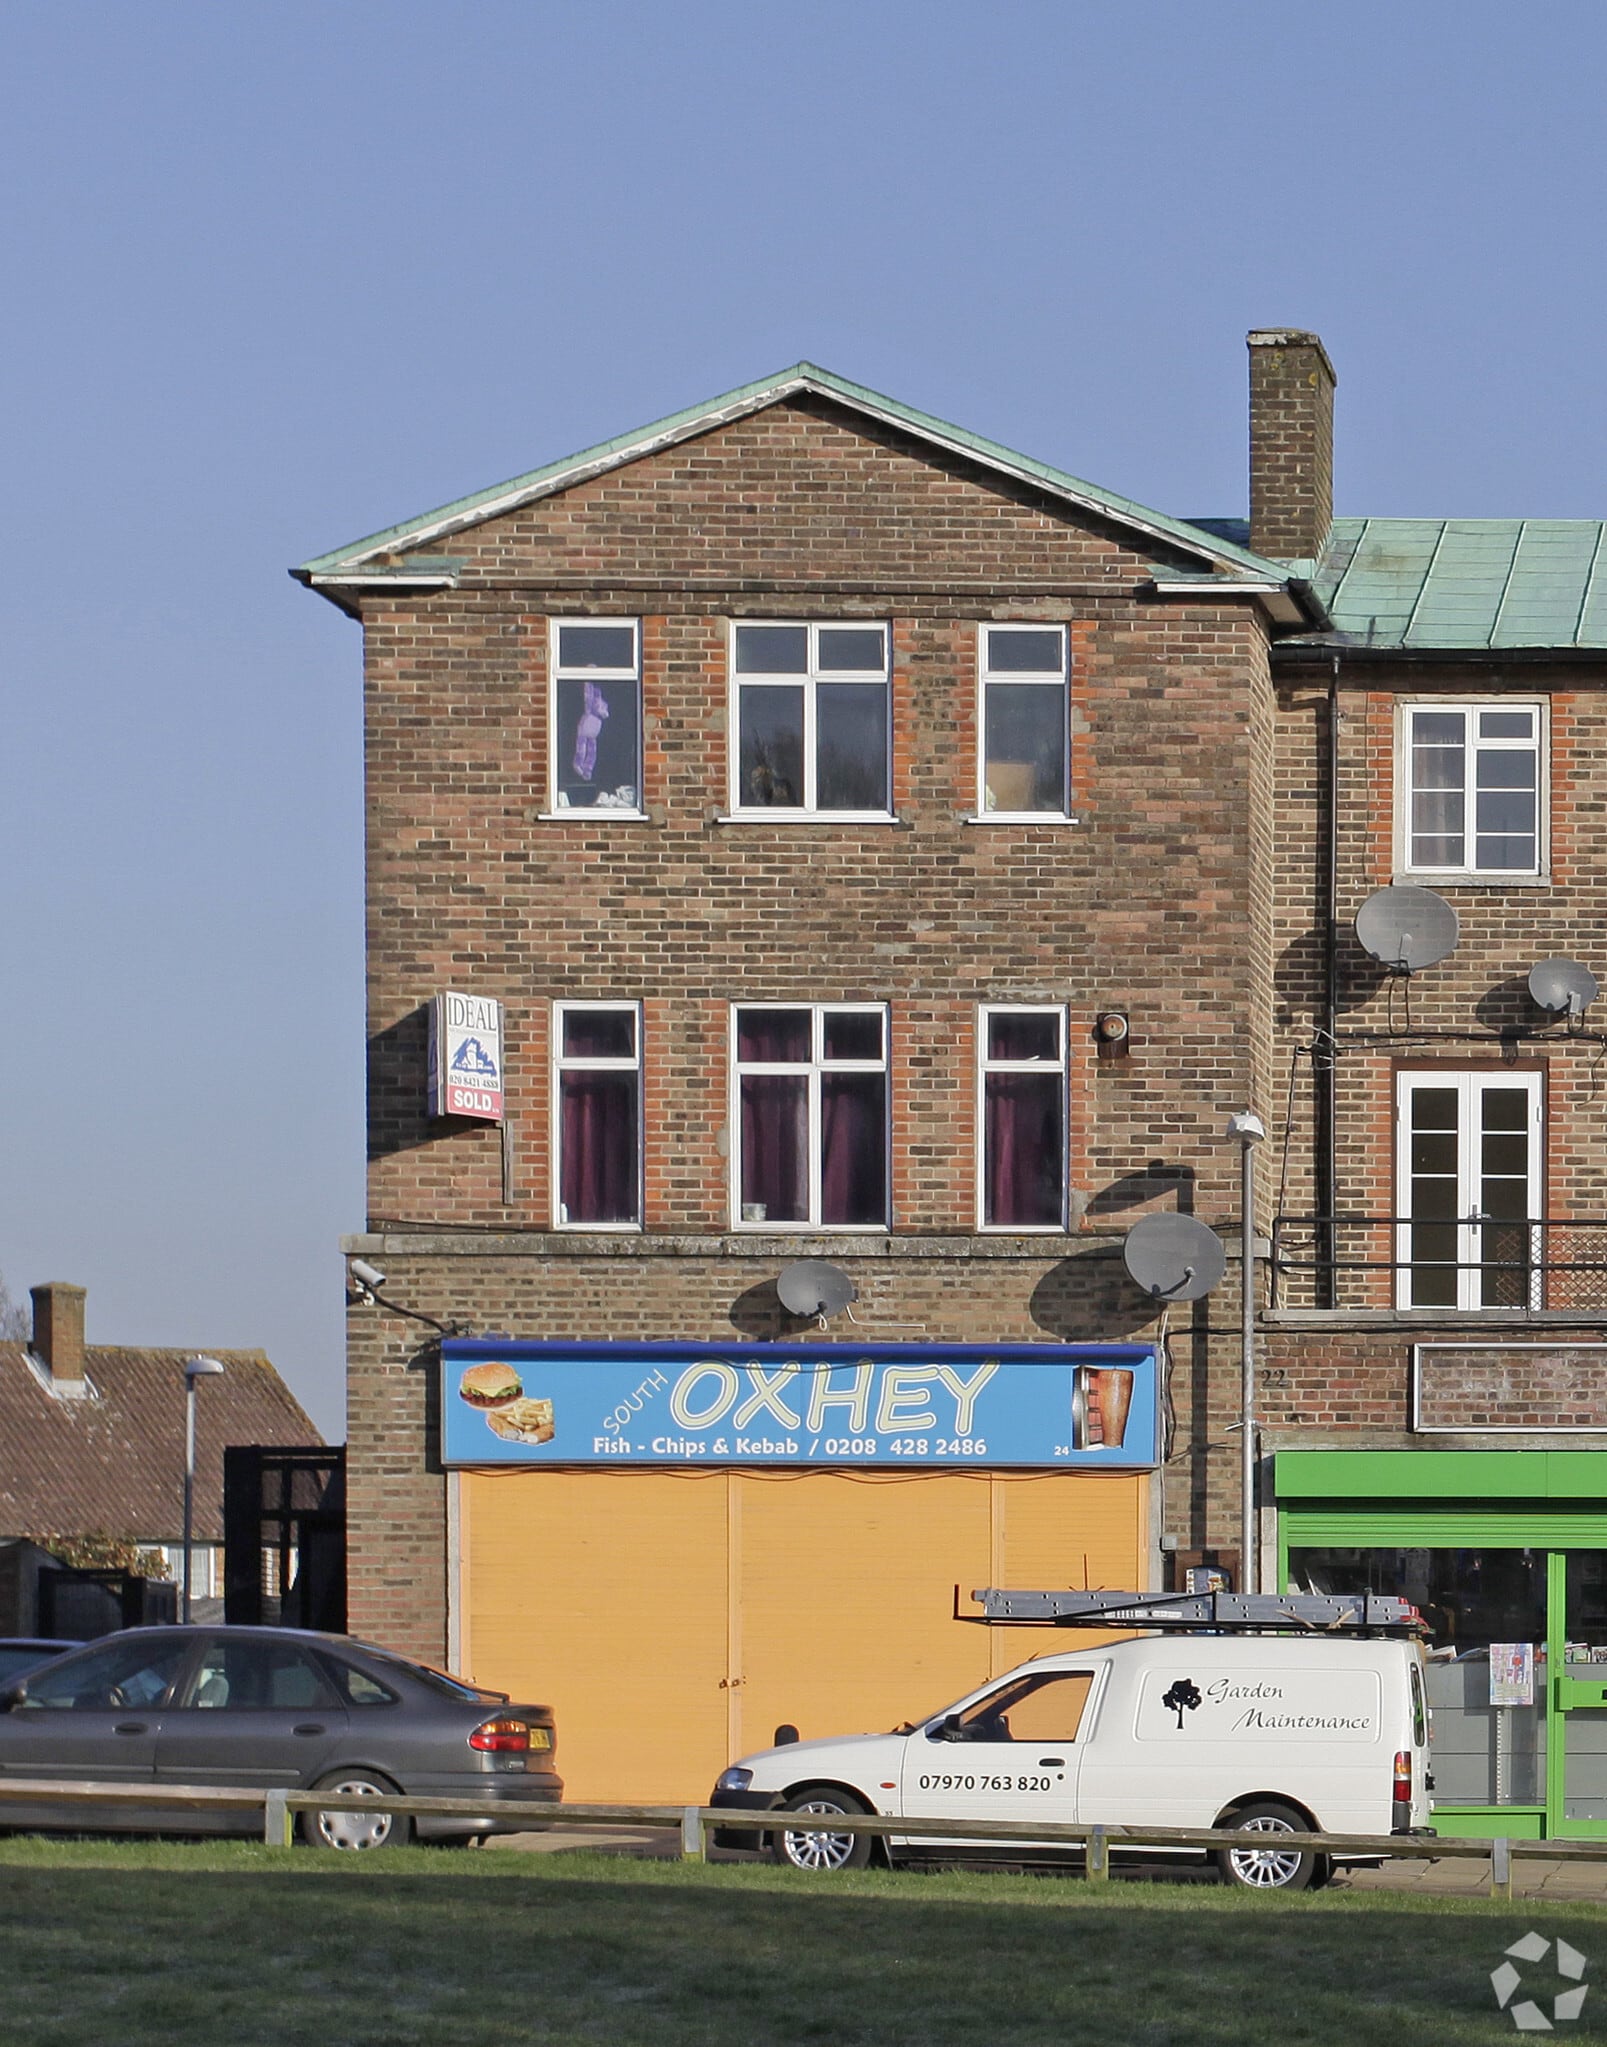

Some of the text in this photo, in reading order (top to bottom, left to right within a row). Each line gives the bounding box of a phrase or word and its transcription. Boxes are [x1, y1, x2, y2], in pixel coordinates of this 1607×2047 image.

[447, 996, 497, 1031] IDEAL
[453, 1089, 492, 1112] SOLD
[1260, 1369, 1288, 1387] 22
[603, 1368, 670, 1435] SOUTH
[670, 1359, 999, 1436] OXHEY
[593, 1437, 631, 1454] Fish
[652, 1437, 706, 1458] Chips
[713, 1438, 730, 1454] &
[736, 1437, 798, 1455] Kebab
[825, 1438, 877, 1455] 0208
[890, 1438, 928, 1455] 428
[935, 1438, 987, 1455] 2486
[1054, 1445, 1070, 1456] 24
[1206, 1678, 1283, 1704] Garden
[1231, 1708, 1370, 1732] Maintenance
[919, 1775, 1051, 1791] 07970 763 820
